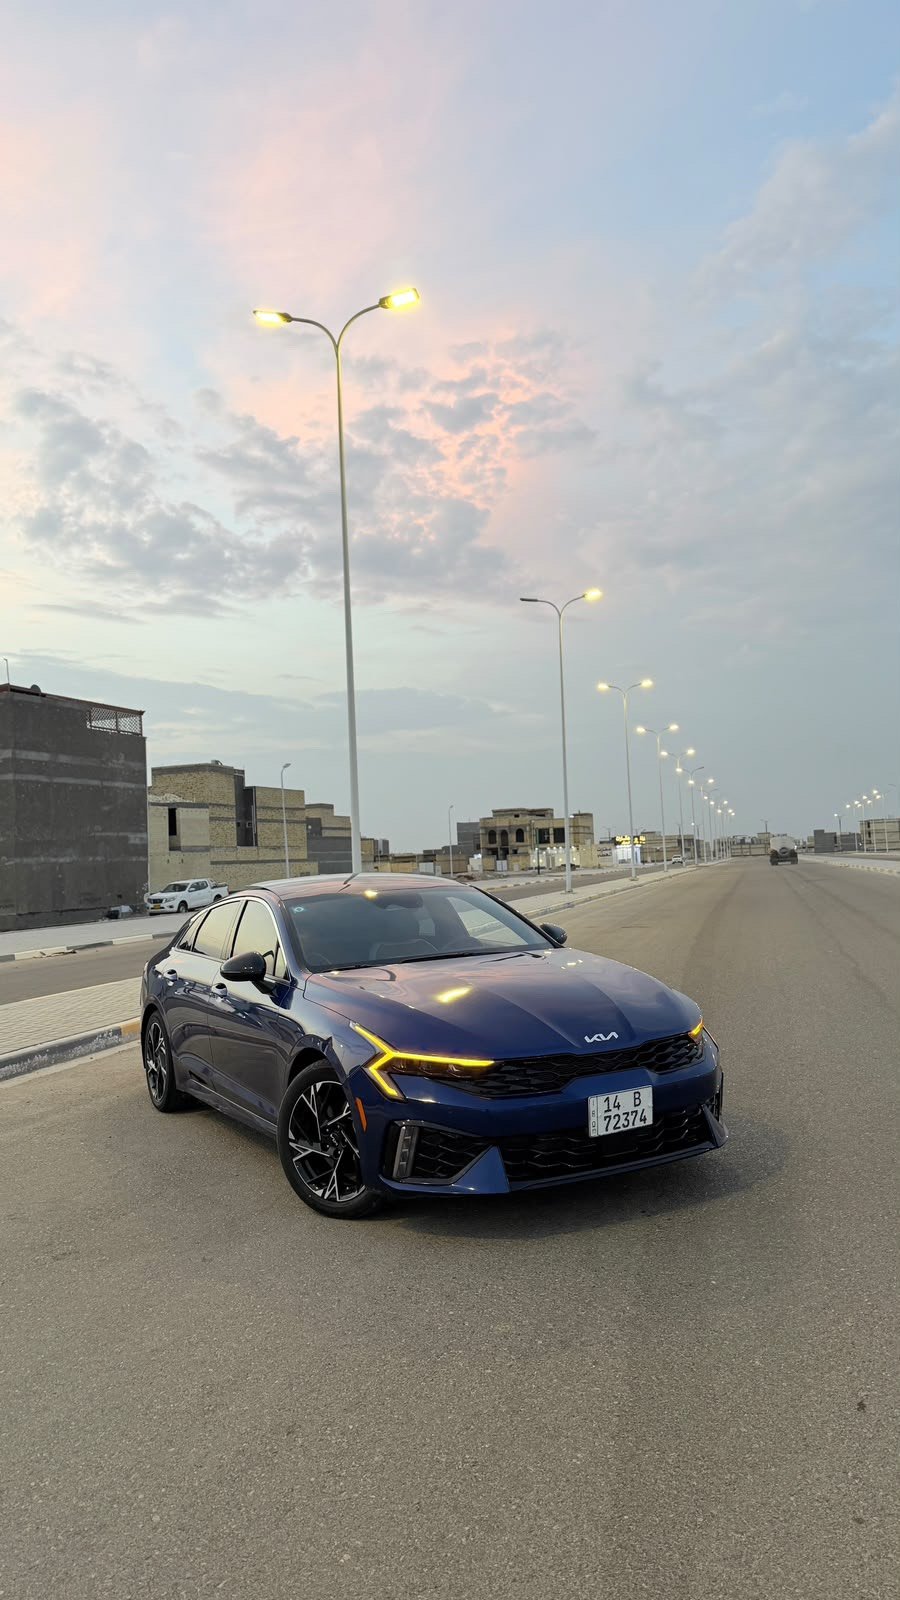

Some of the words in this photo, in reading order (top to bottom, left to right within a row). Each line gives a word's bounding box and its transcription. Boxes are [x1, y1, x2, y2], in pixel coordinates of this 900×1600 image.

[584, 1031, 619, 1043] KIA
[603, 1095, 621, 1114] 14
[633, 1091, 642, 1108] B
[603, 1108, 648, 1132] 72374
